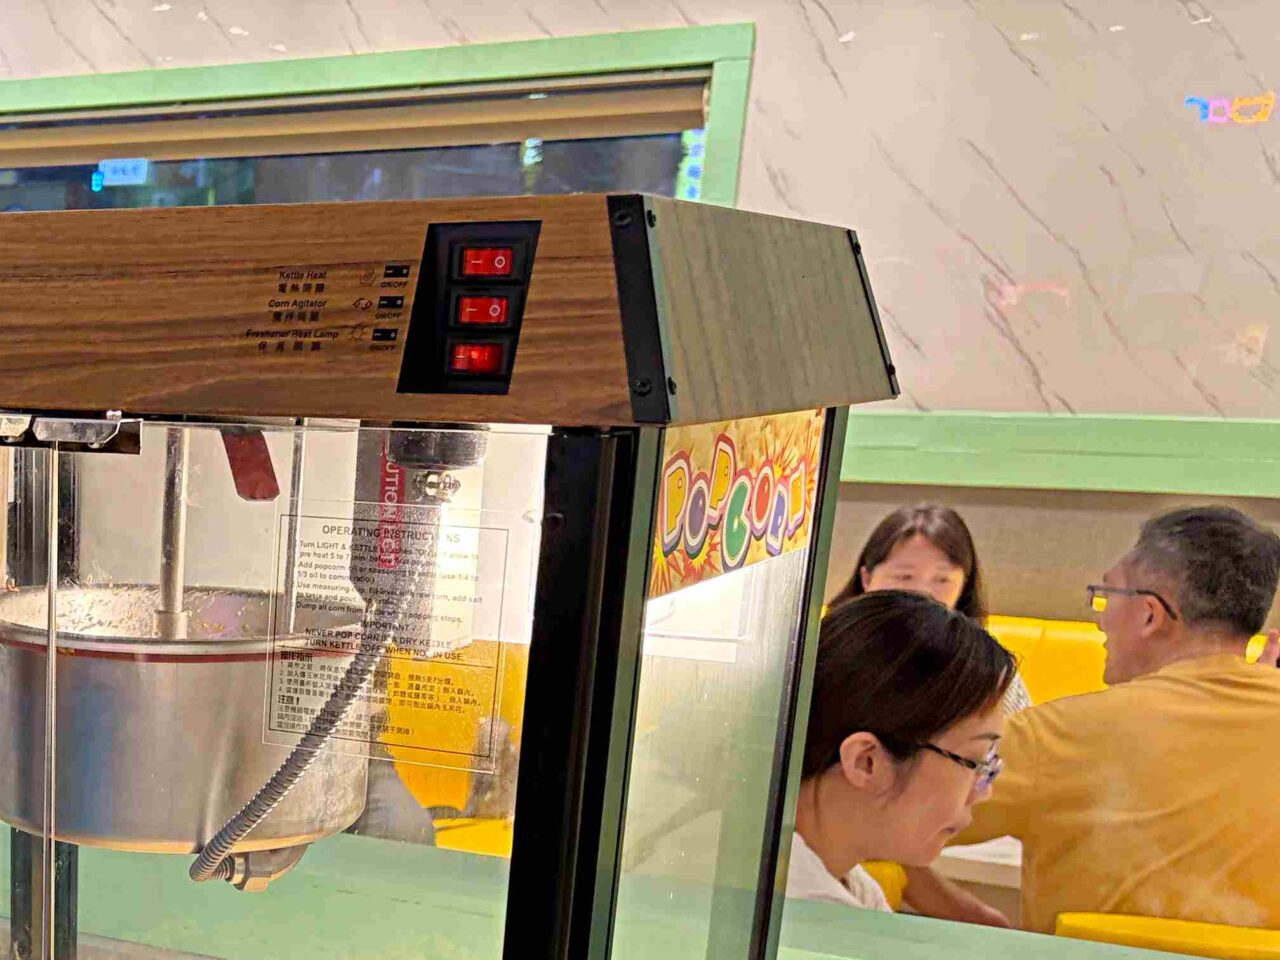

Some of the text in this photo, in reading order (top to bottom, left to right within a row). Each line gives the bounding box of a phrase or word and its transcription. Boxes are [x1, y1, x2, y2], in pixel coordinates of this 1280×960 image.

[279, 271, 327, 280] Kettle Heat
[291, 299, 328, 309] Agitator
[292, 329, 311, 338] Heat
[314, 330, 339, 340] Lamp
[660, 433, 808, 573] POPCORN
[322, 524, 461, 543] OPERATING INSTRUCNS
[300, 540, 315, 549] Turn
[317, 541, 339, 550] LIGHT
[299, 551, 311, 559] pre
[313, 551, 328, 559] heat
[336, 552, 344, 560] to
[298, 561, 313, 569] Add
[309, 571, 318, 579] oil
[319, 572, 327, 580] to
[297, 581, 311, 589] Use
[312, 583, 350, 593] measuring
[324, 593, 338, 601] and
[296, 600, 317, 611] Dump
[318, 602, 327, 610] all
[346, 605, 363, 613] from
[305, 627, 334, 638] NEVER
[335, 630, 353, 639] POP
[354, 632, 379, 642] CORN
[391, 635, 398, 643] A
[399, 636, 418, 646] DRY
[419, 638, 452, 650] KELE
[305, 636, 327, 647] TURN
[329, 640, 361, 651] KETTLE
[386, 645, 411, 656] WHEN
[433, 651, 442, 659] IN
[444, 652, 464, 661] USE
